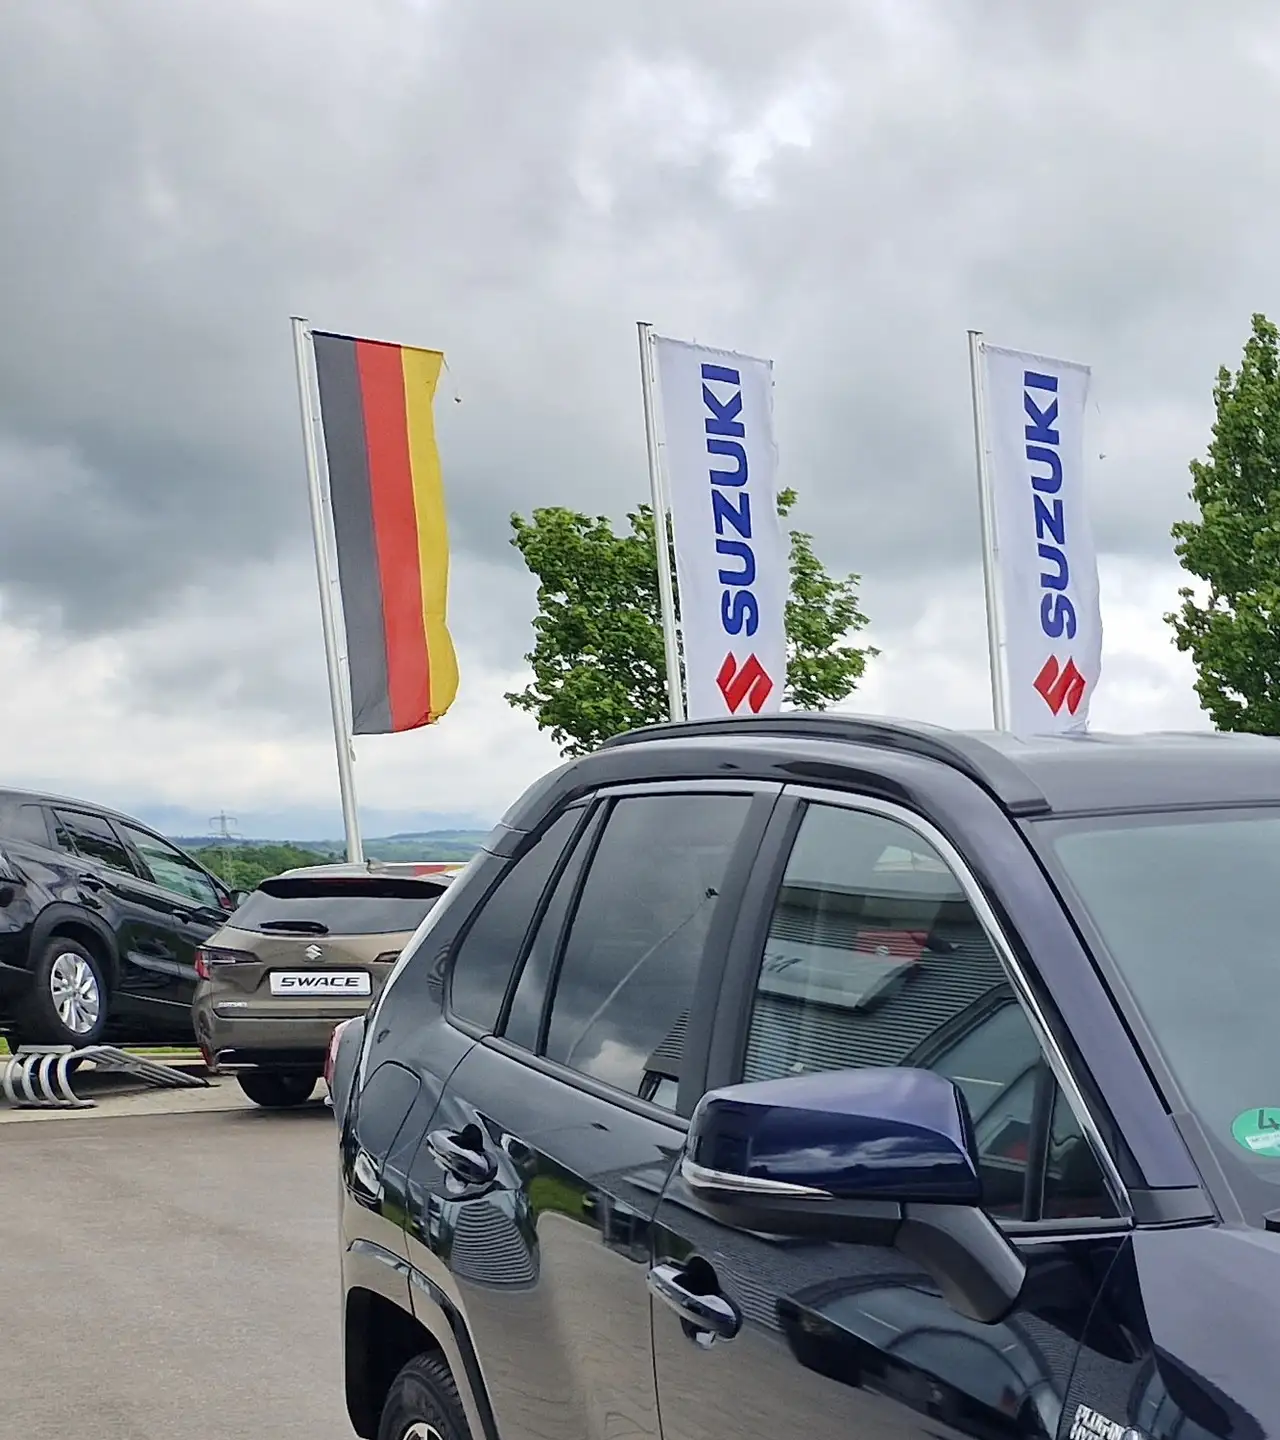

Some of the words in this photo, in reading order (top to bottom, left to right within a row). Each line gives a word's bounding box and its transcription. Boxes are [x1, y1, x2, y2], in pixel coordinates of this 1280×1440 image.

[701, 363, 759, 637] SUZUKI
[1024, 371, 1077, 640] SUZUKI
[280, 977, 360, 987] SWACE
[1258, 1109, 1280, 1130] 4
